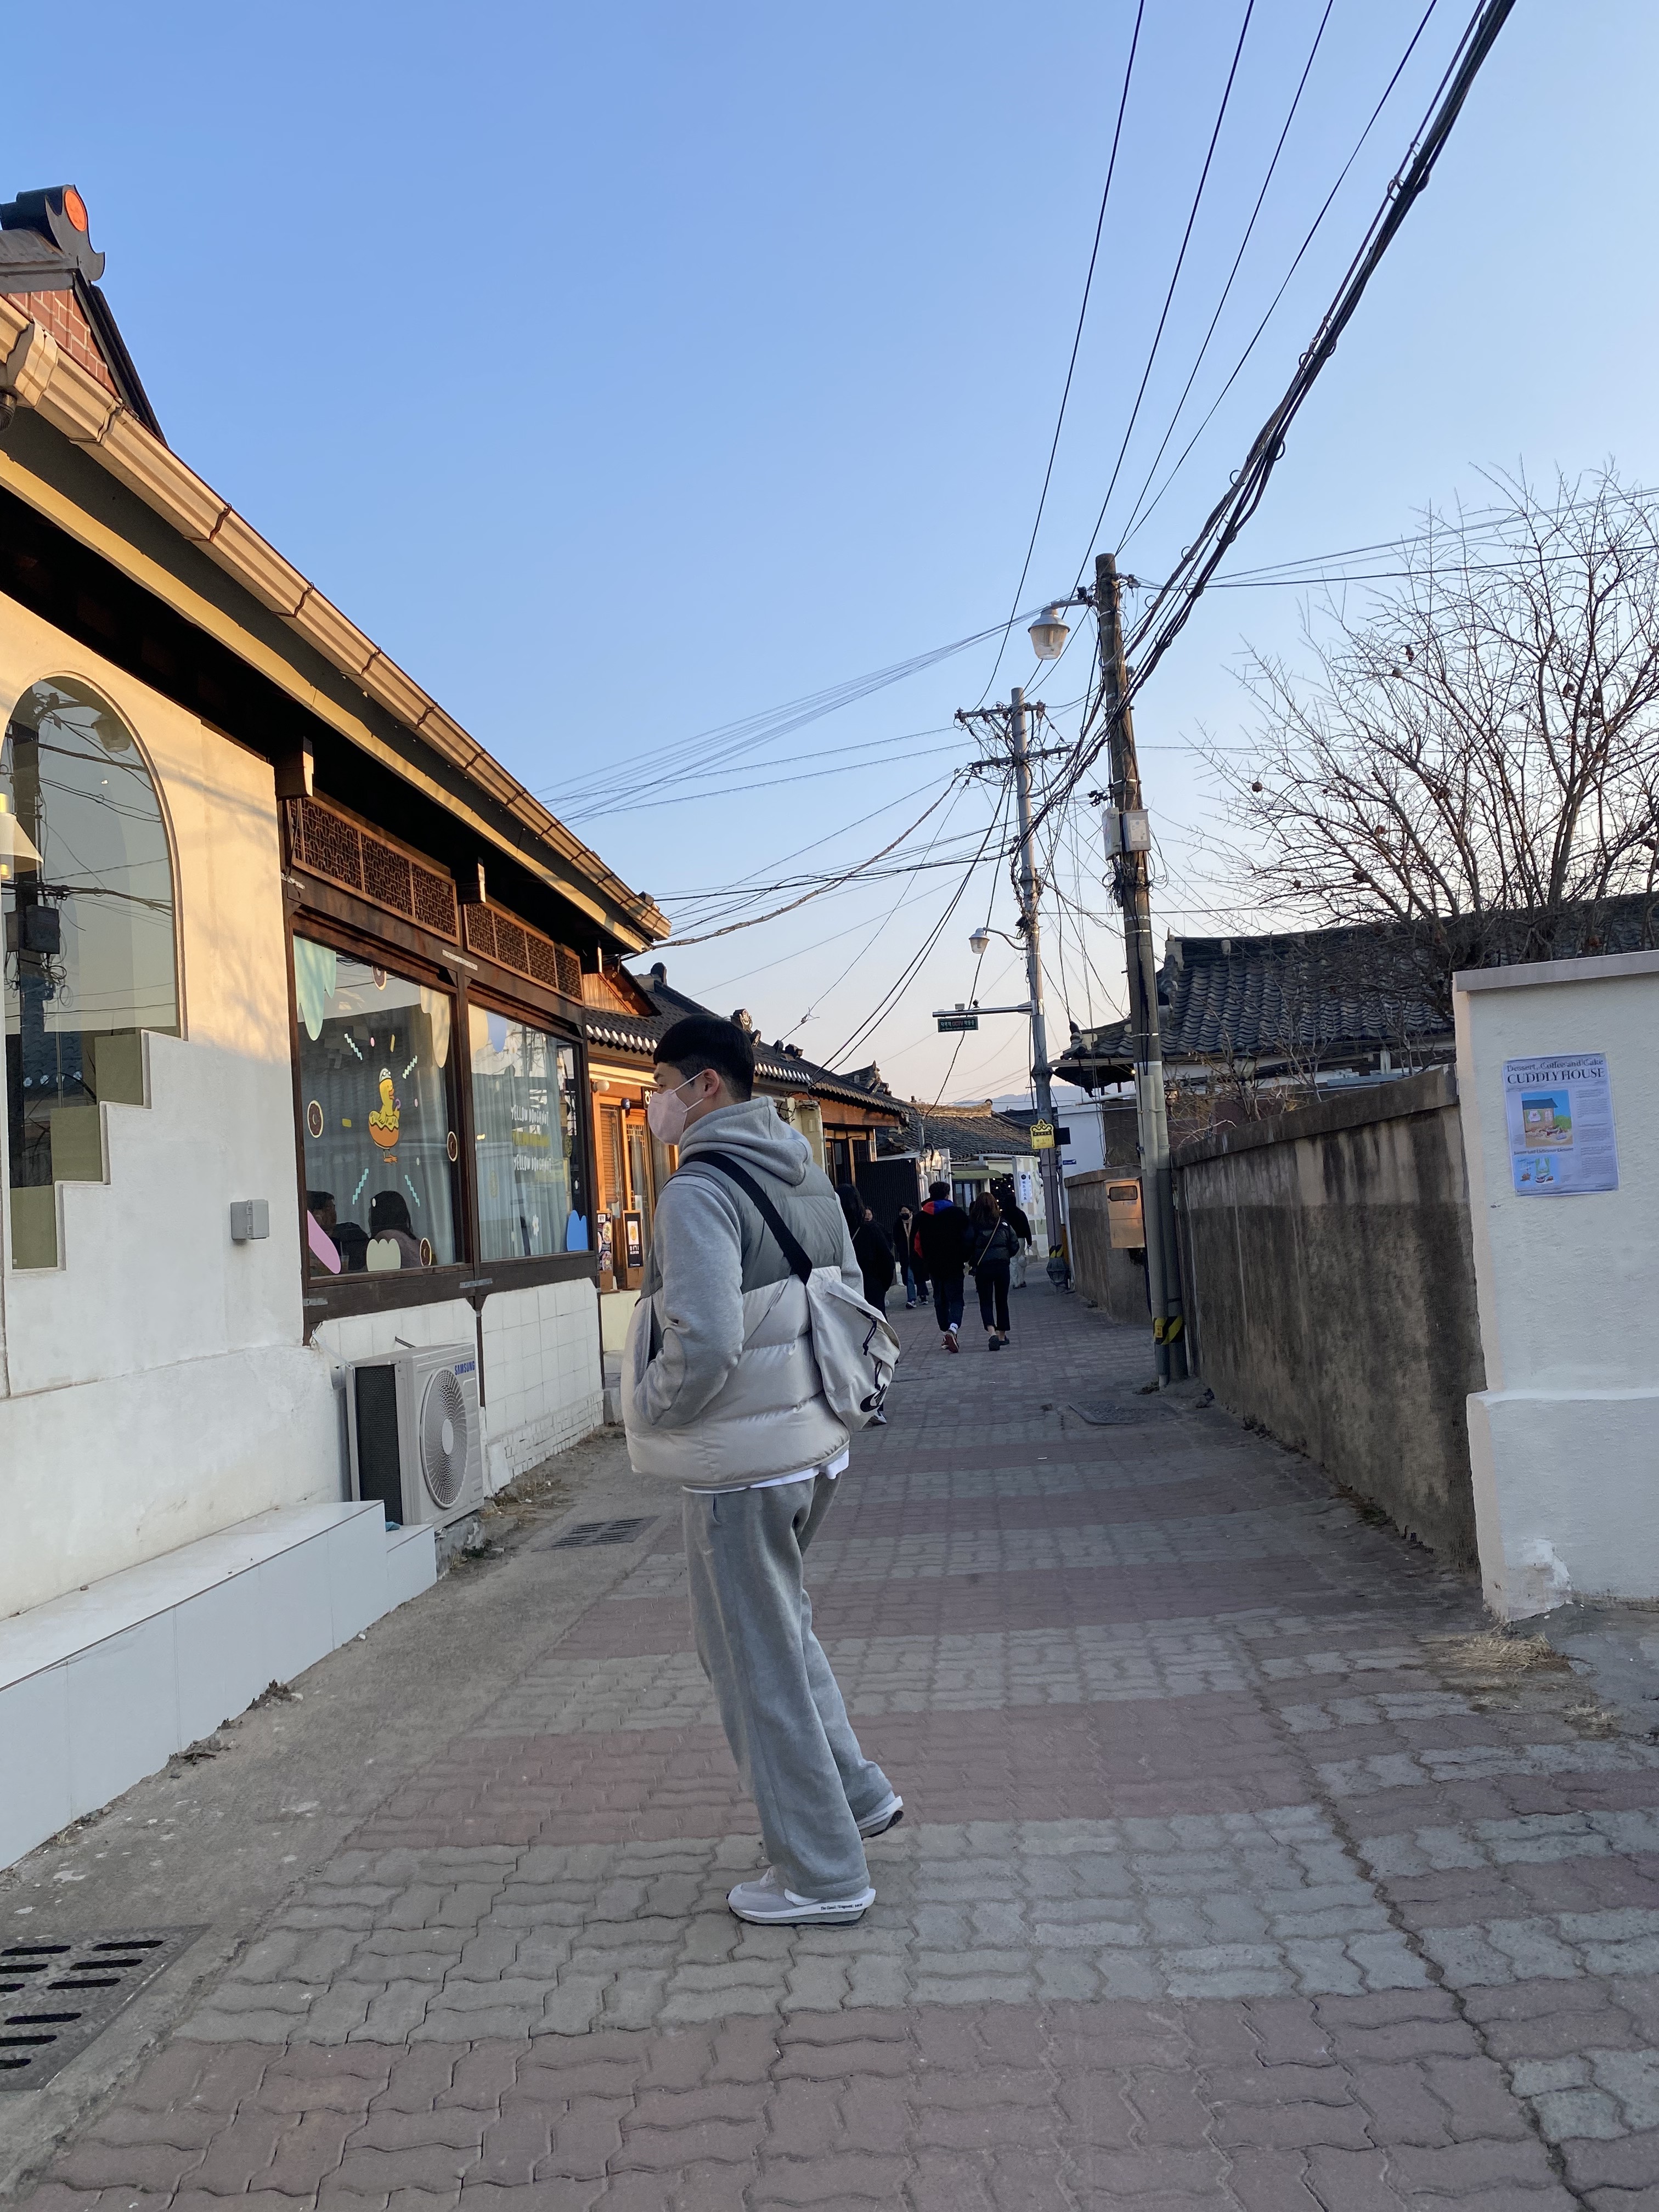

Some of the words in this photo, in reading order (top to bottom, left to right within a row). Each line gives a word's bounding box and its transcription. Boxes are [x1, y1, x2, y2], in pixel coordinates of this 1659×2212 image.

[1507, 1063, 1541, 1073] Dessert,
[1541, 1061, 1566, 1069] Coffee
[1507, 1070, 1558, 1085] CUDDLY
[1561, 1067, 1605, 1080] HOUSE
[511, 1104, 528, 1122] YELLOW
[514, 1154, 530, 1171] YELLOW
[454, 1361, 475, 1375] SAMSUNG
